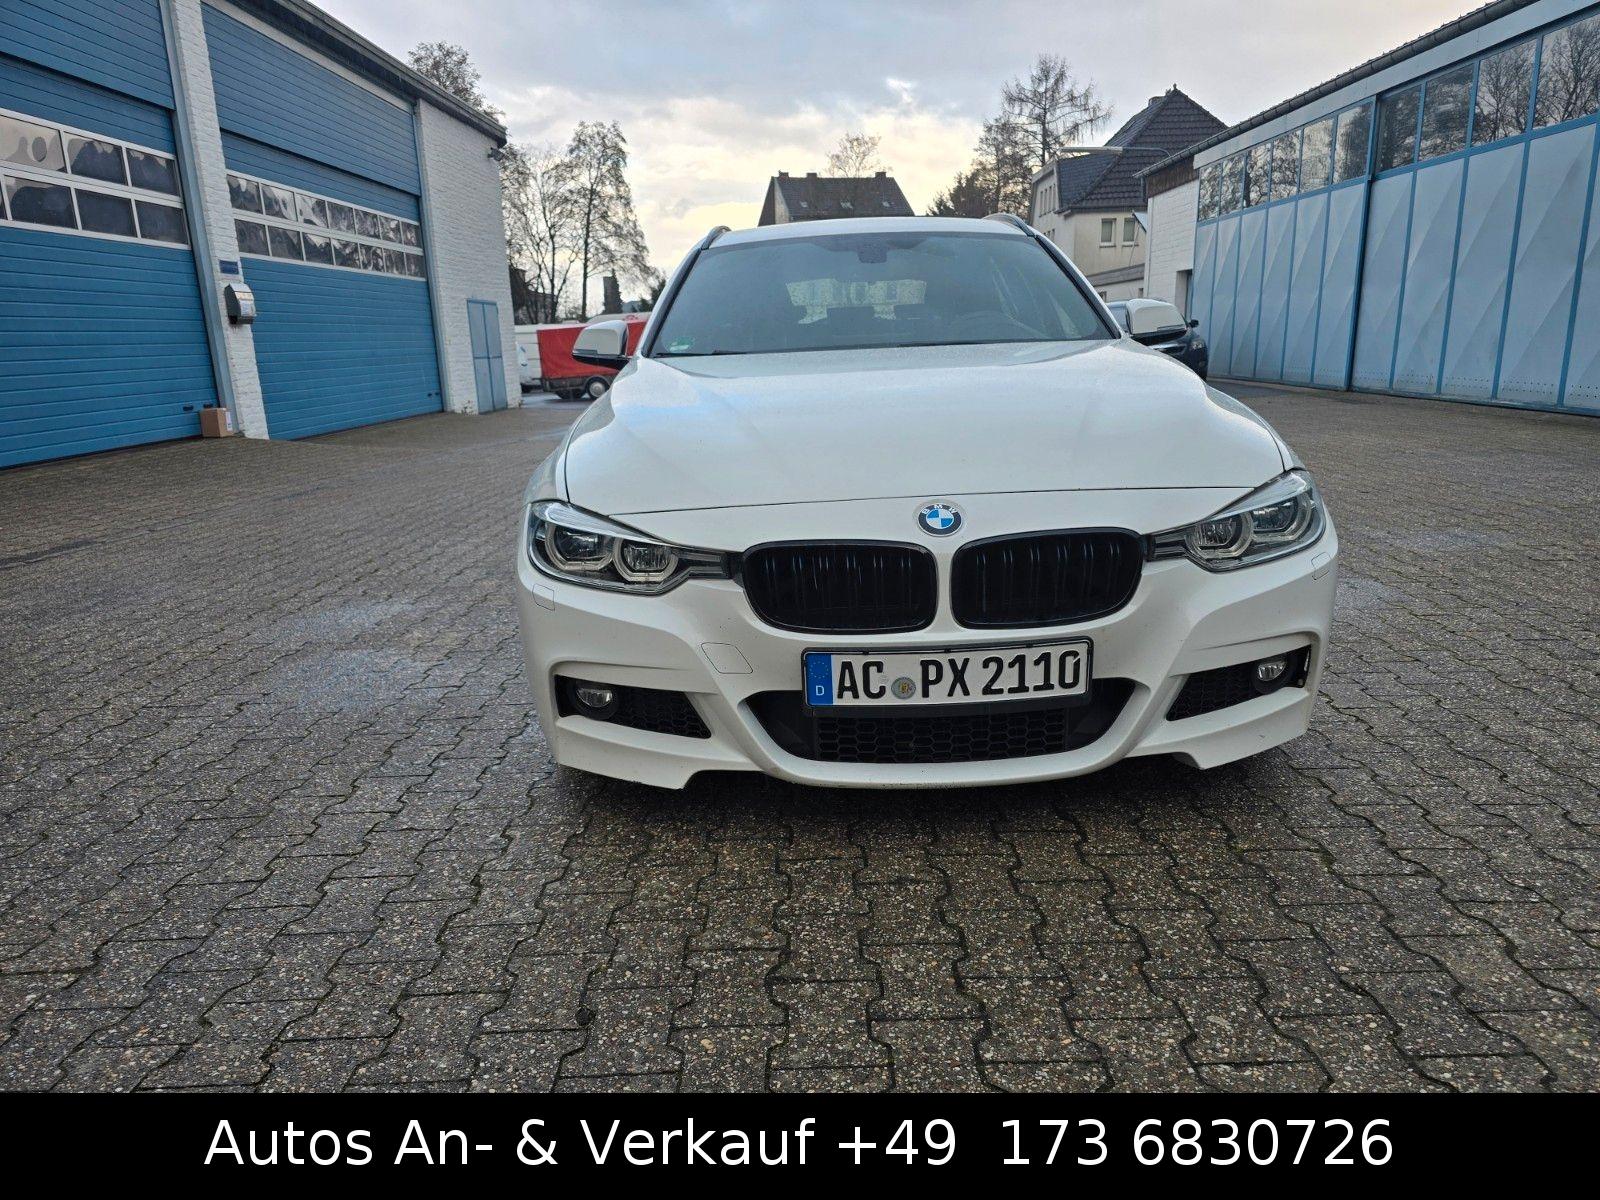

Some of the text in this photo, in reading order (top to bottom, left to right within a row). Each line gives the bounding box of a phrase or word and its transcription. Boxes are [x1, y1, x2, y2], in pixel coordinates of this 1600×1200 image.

[837, 649, 1081, 700] AC PX 2110
[815, 685, 825, 696] D
